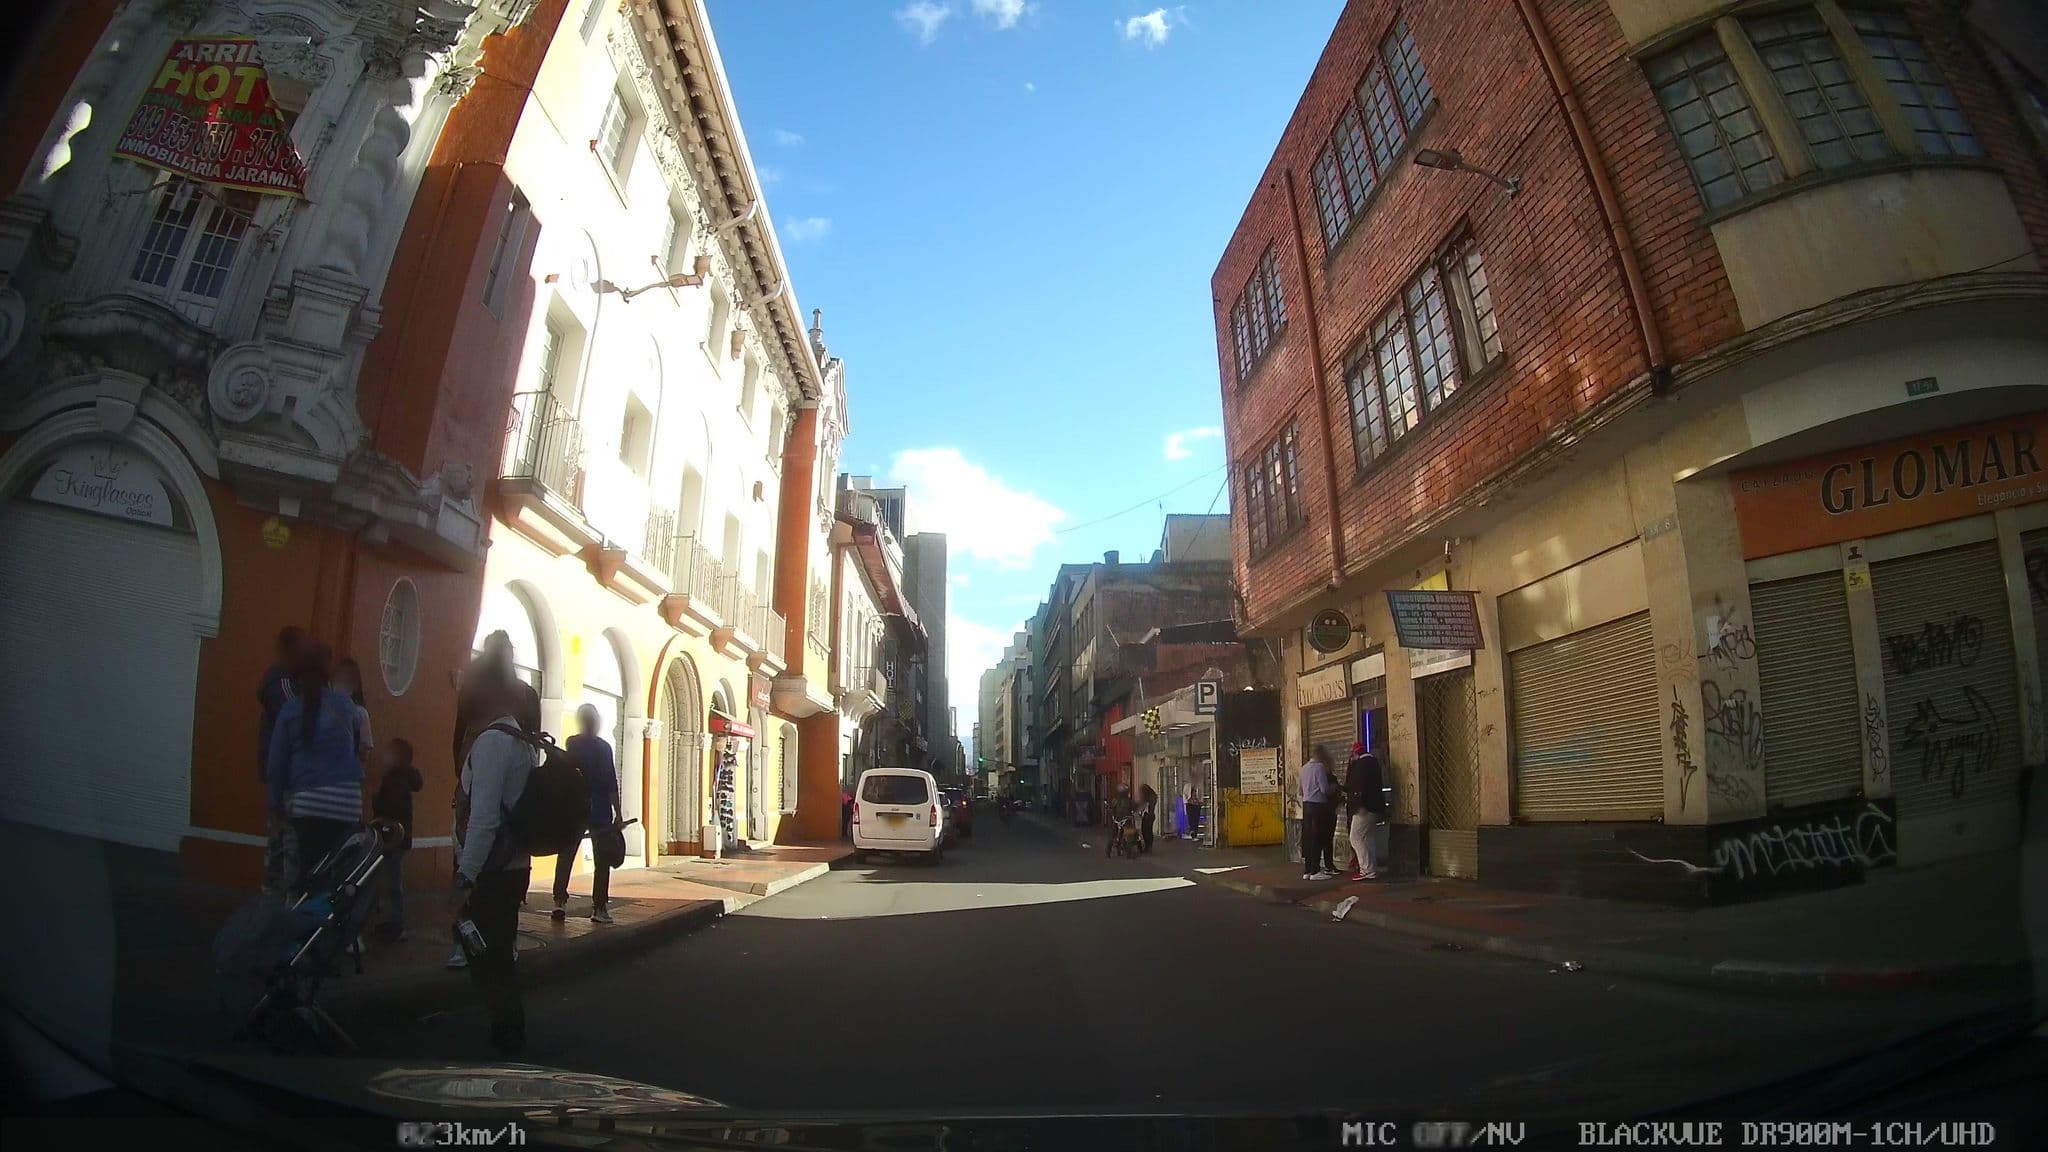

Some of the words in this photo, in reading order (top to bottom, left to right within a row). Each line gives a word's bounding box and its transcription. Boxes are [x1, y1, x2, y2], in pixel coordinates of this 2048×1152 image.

[119, 137, 222, 177] INMOBILIARIA
[55, 470, 154, 508] Kinglasses
[1821, 428, 2042, 516] GLOMAR
[1200, 684, 1215, 703] P
